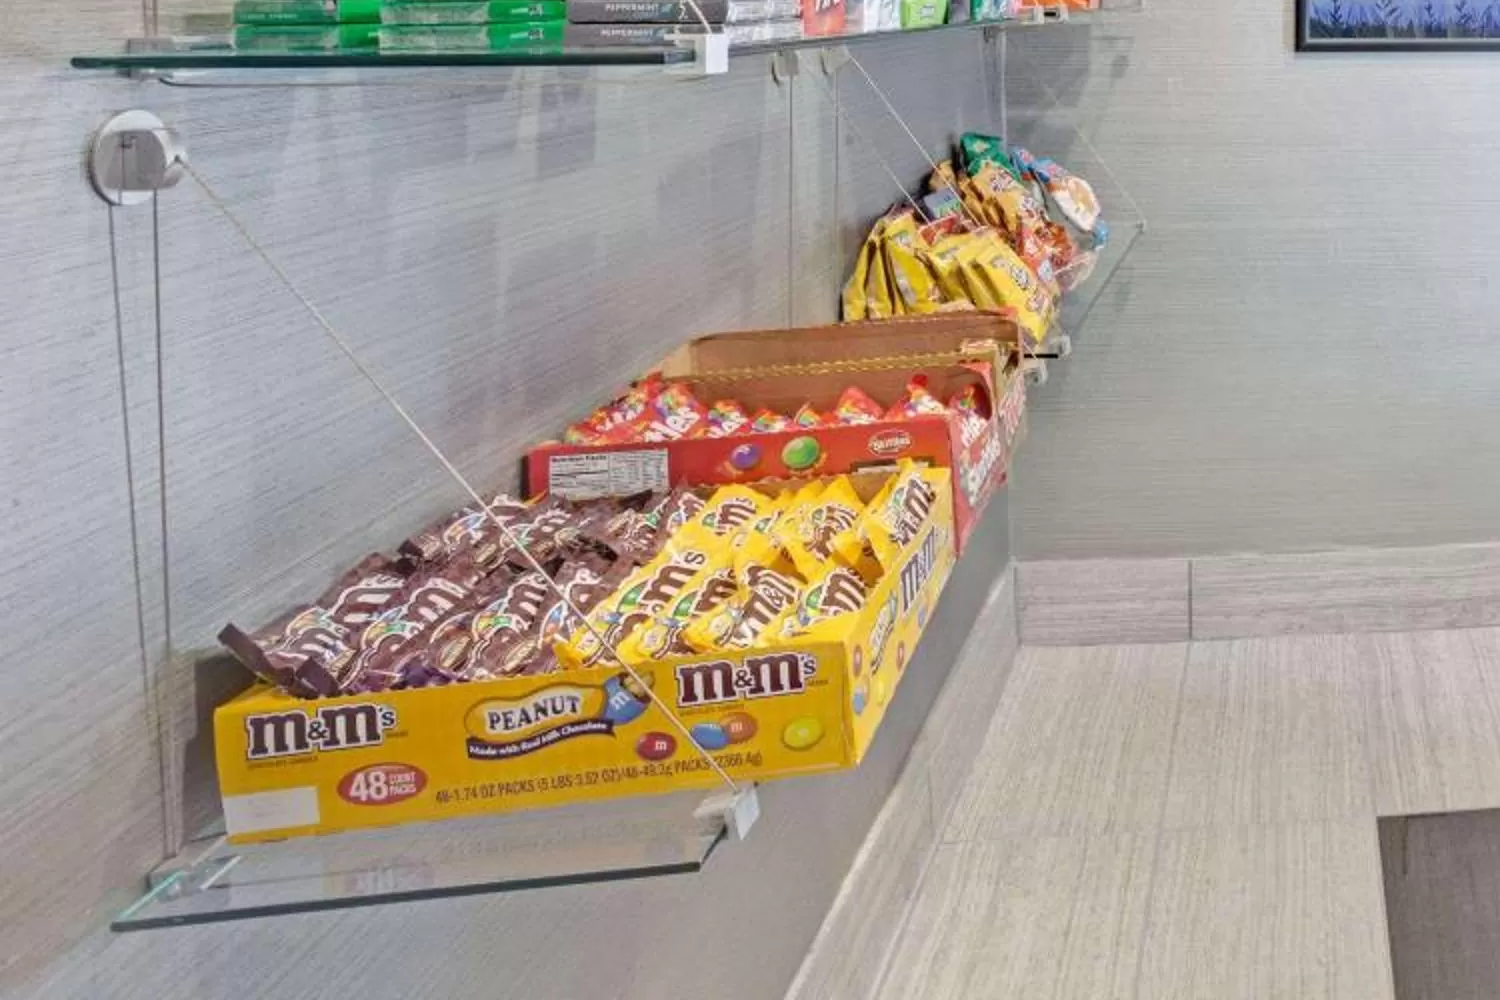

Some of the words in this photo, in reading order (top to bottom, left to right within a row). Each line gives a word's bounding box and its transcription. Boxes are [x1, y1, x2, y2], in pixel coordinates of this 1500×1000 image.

[604, 3, 660, 13] PEPPERMINT
[677, 653, 817, 704] m&m's
[248, 704, 396, 758] m&m's
[486, 695, 581, 732] PEANUT
[469, 744, 498, 757] Made
[500, 742, 520, 755] with
[520, 735, 541, 751] Real
[560, 721, 608, 736] Chocolate
[350, 770, 389, 802] 48
[480, 783, 496, 798] OZ
[499, 777, 536, 797] PACKS
[551, 774, 573, 790] LBS
